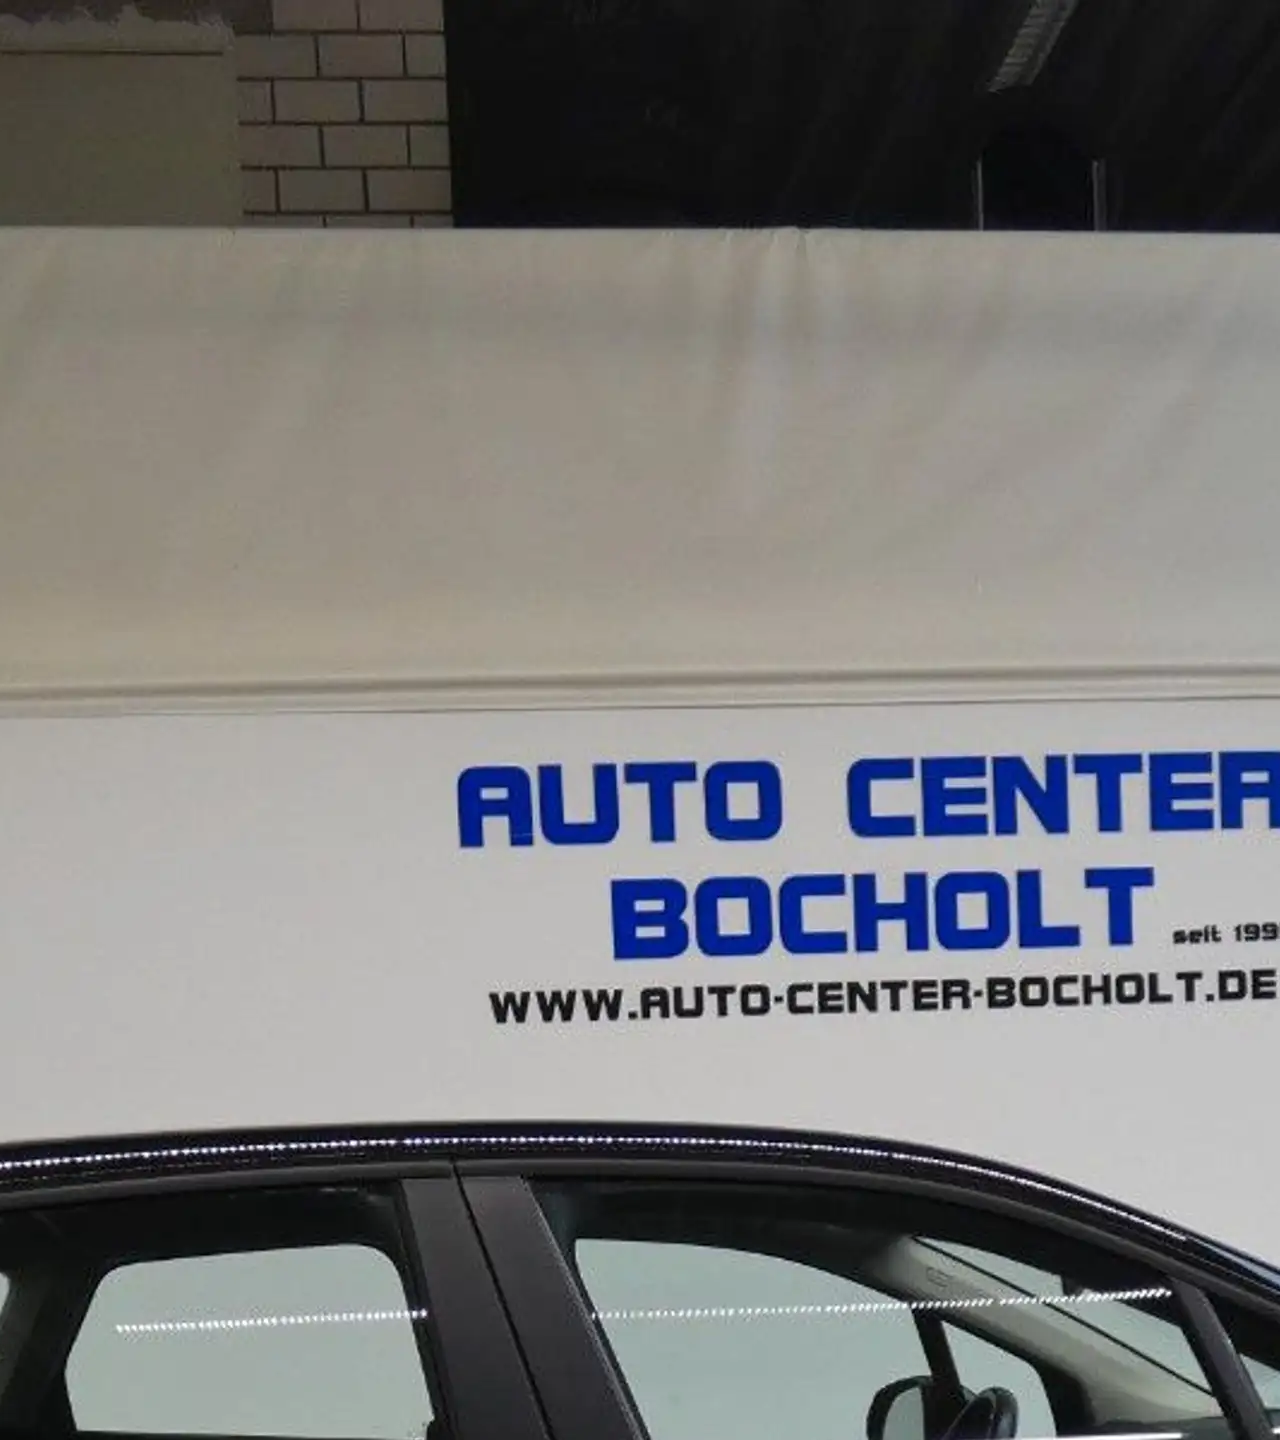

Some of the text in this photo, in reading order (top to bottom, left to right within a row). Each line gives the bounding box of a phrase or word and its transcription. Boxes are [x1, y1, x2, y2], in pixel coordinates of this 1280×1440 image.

[456, 760, 783, 849] AUTO
[610, 866, 1155, 961] BOCHOLT
[1172, 924, 1222, 945] seit
[488, 968, 1278, 1024] WWW.AUTO-CENTER-BOCHOLT.DE
